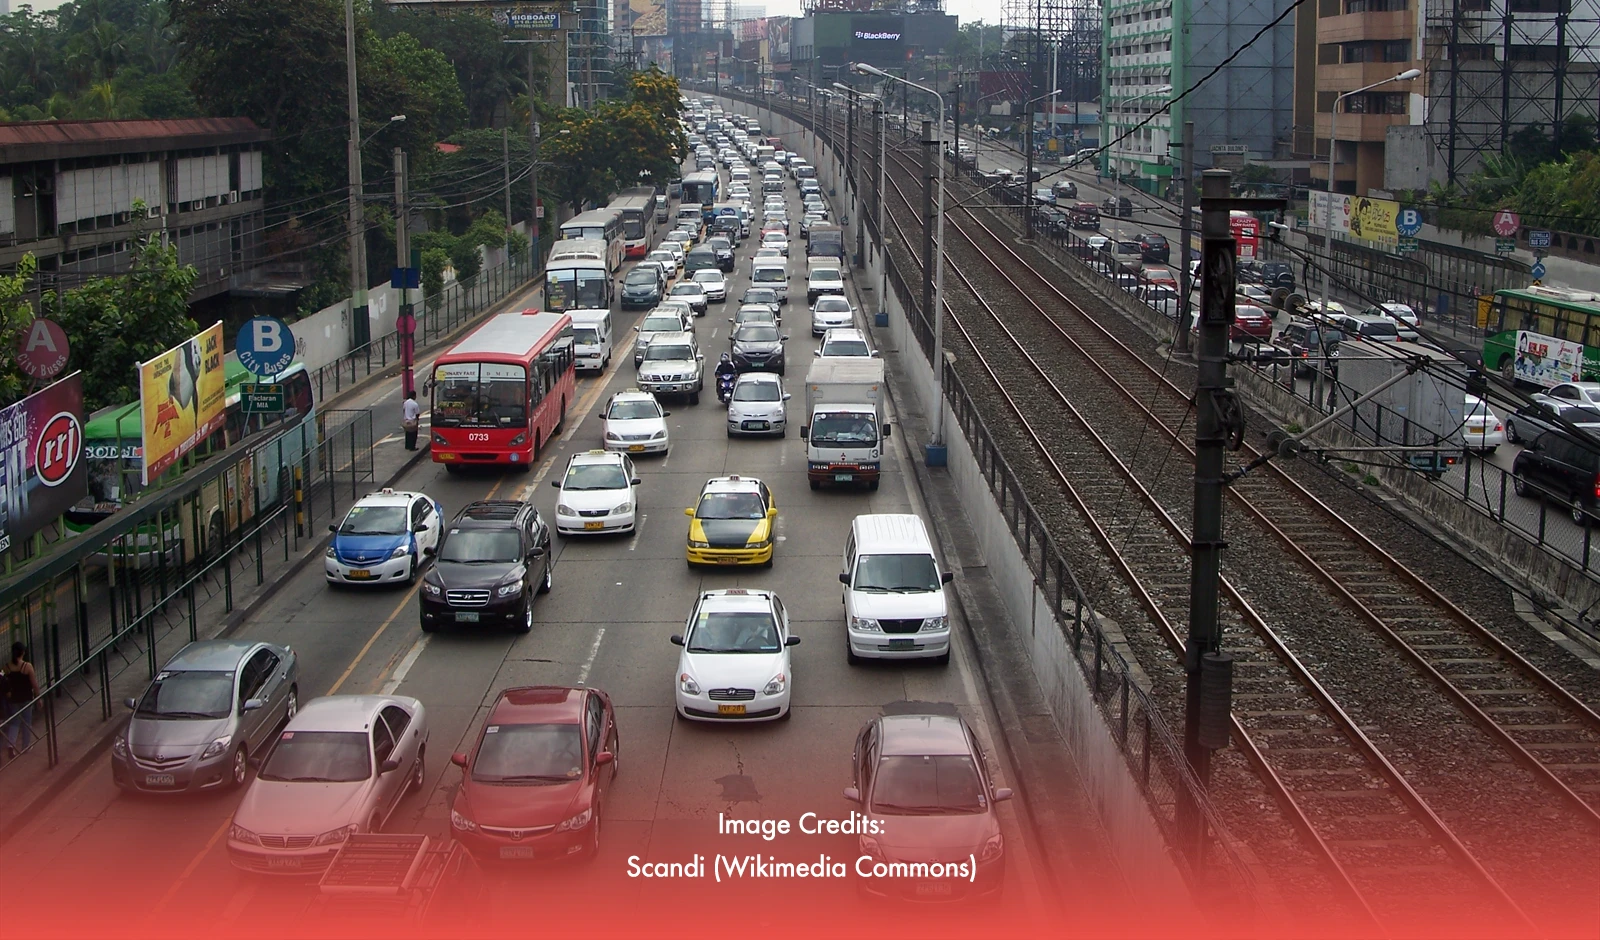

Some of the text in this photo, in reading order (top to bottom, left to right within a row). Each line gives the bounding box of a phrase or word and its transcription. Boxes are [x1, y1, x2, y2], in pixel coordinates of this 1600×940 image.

[863, 32, 901, 41] BlackBerry
[1404, 210, 1417, 225] B
[1499, 209, 1514, 224] A
[26, 320, 57, 352] A
[206, 335, 217, 354] JACK
[252, 320, 282, 352] B
[17, 353, 66, 376] City Buses
[205, 352, 220, 375] BLACK
[240, 351, 291, 375] City Buses
[14, 411, 28, 442] GOT
[468, 433, 489, 441] 0733
[43, 420, 75, 469] rrj
[871, 449, 879, 459] 3
